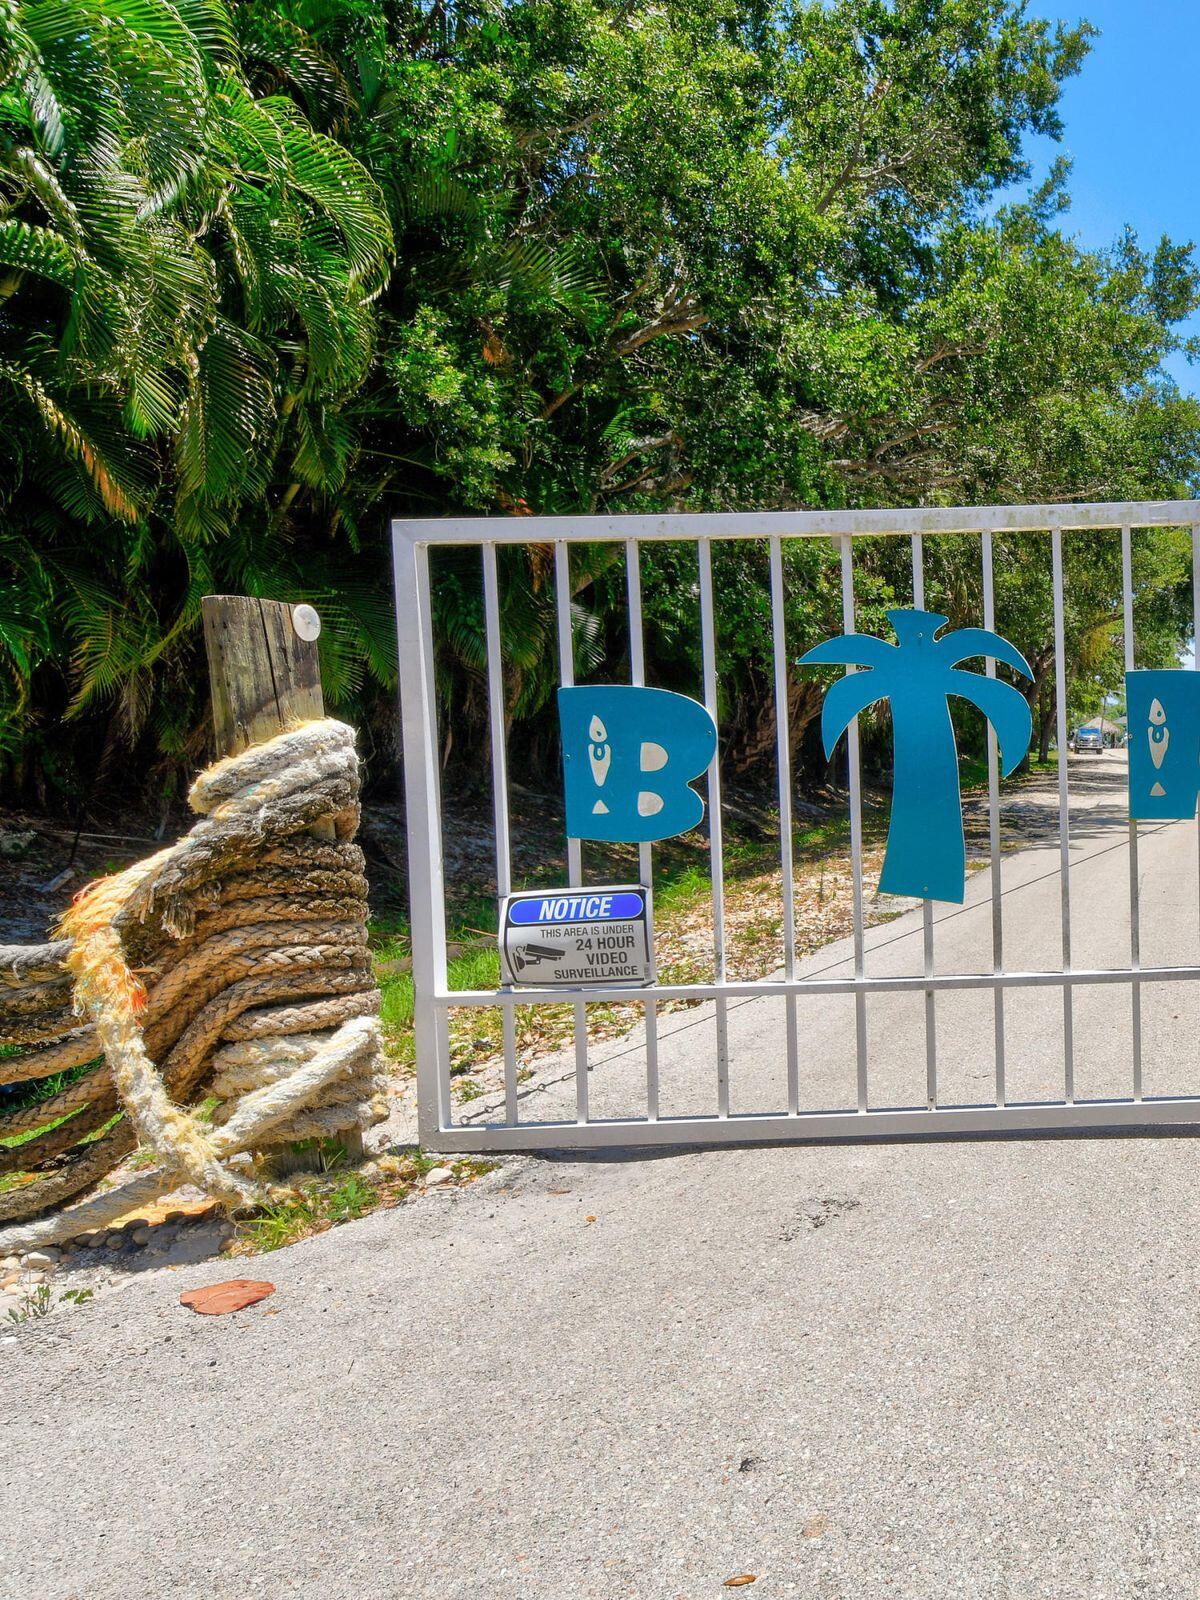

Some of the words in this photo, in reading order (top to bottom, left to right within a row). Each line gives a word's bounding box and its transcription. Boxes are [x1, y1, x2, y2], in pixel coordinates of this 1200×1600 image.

[539, 897, 613, 920] NOTICE
[541, 928, 561, 938] THIS
[564, 927, 588, 937] AREA
[591, 926, 600, 935] IS
[603, 924, 634, 935] UNDER
[575, 938, 593, 951] 24
[597, 936, 635, 950] HOUR
[586, 951, 627, 965] VIDEO
[554, 965, 638, 980] SURVEILLANCE
